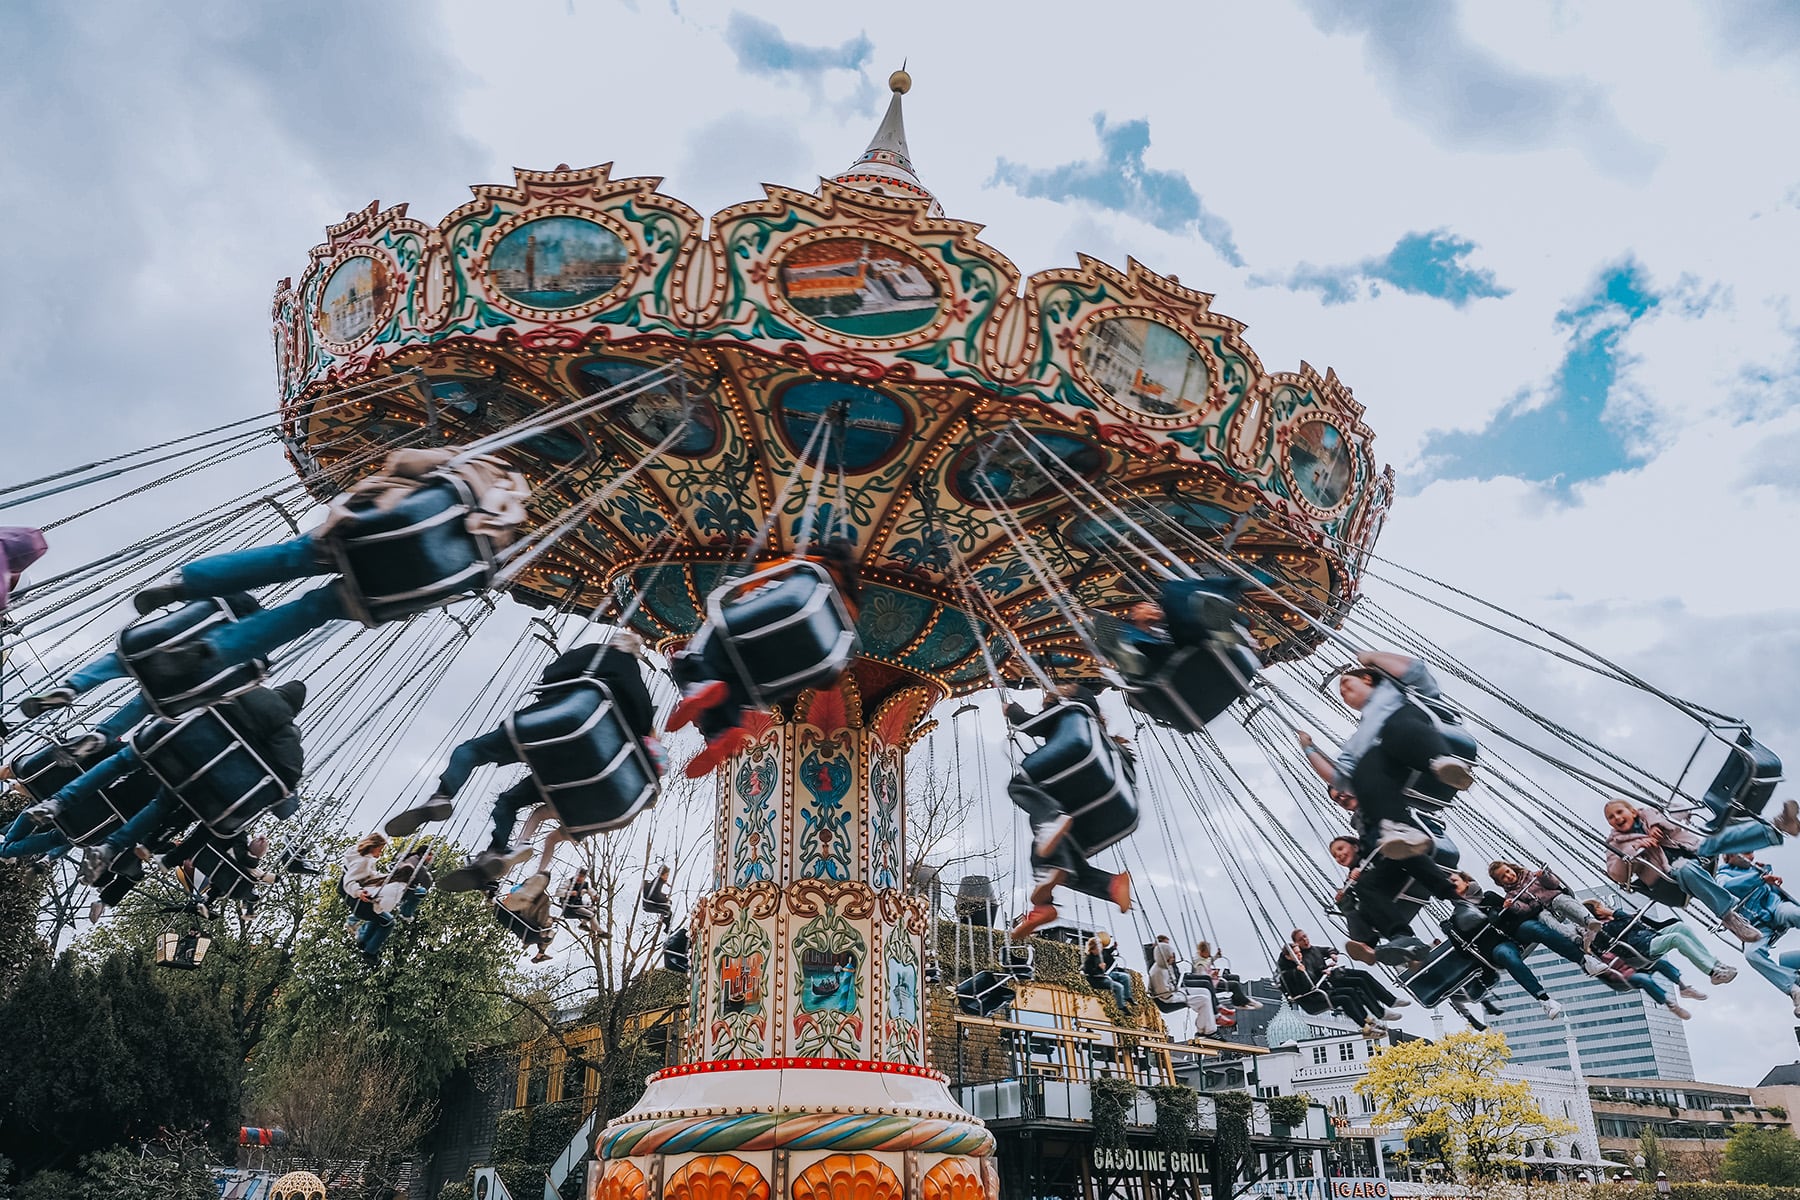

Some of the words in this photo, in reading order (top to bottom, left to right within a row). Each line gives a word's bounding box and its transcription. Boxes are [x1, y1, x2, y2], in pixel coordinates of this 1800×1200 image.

[1094, 1147, 1167, 1172] GASOLINE
[1170, 1151, 1209, 1174] GRILL
[1329, 1181, 1388, 1198] IGARO
